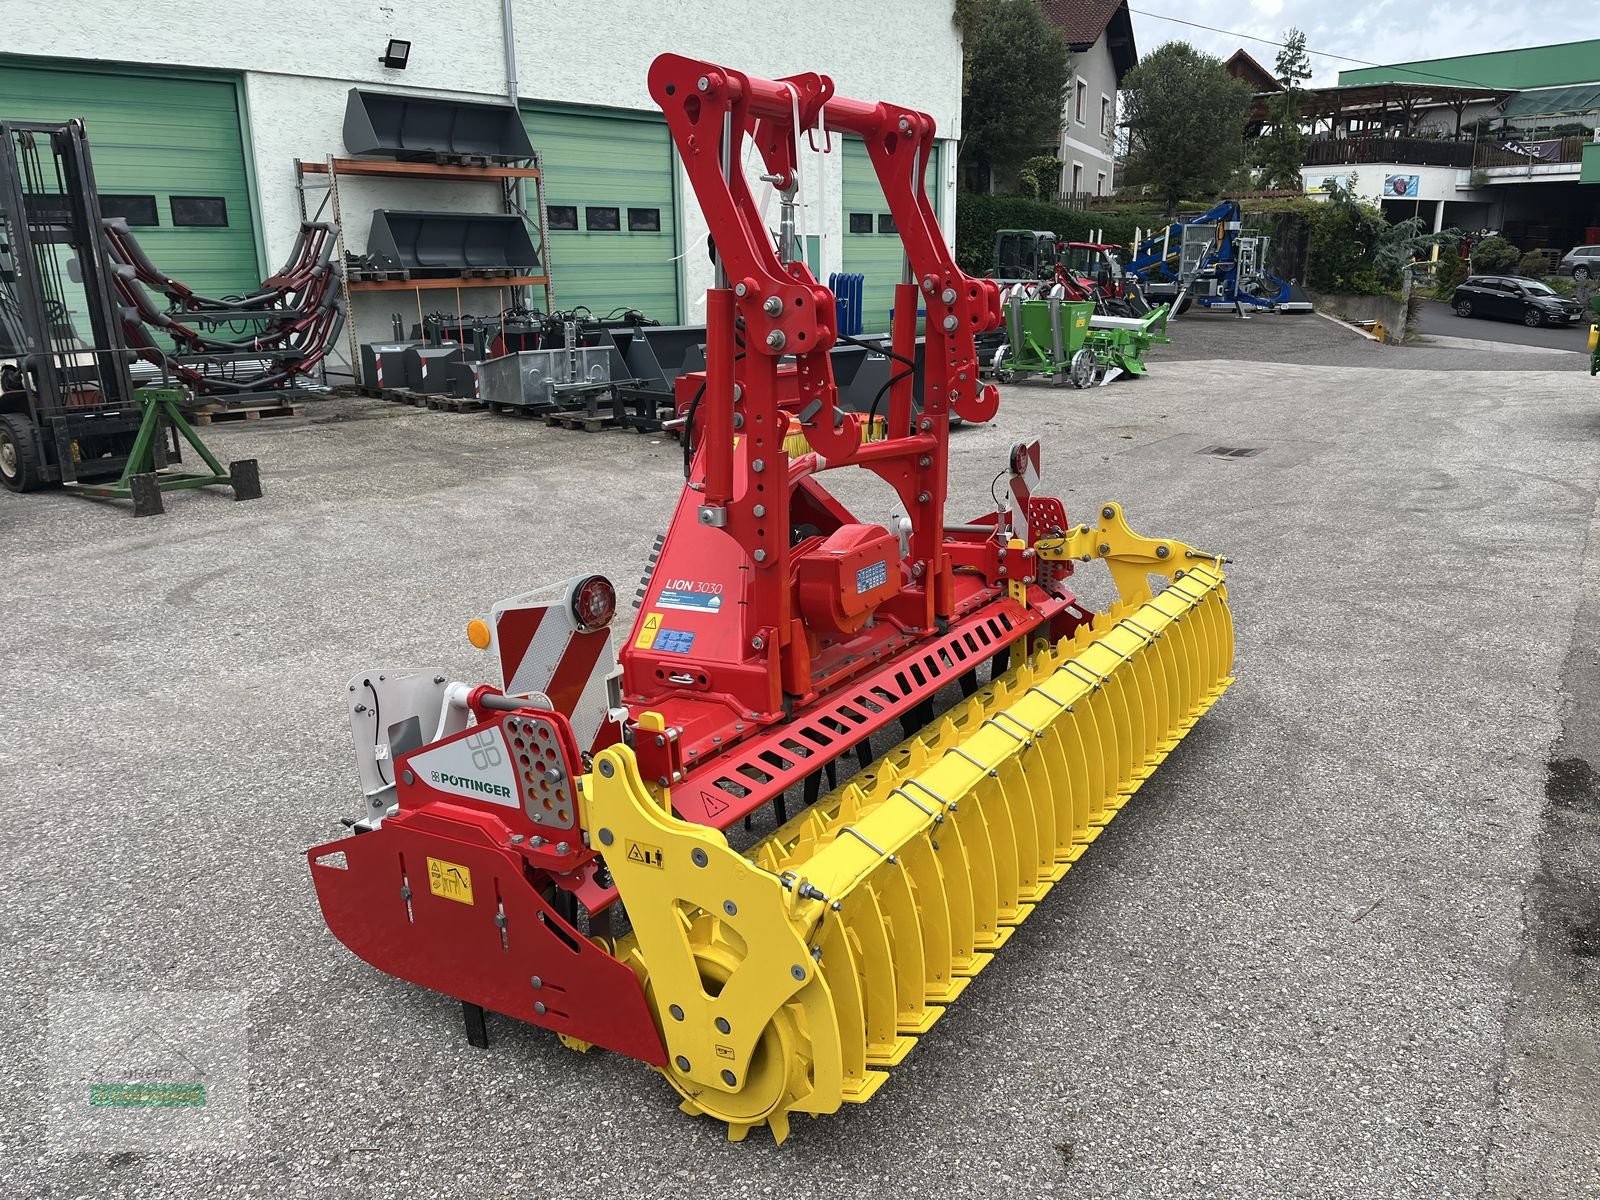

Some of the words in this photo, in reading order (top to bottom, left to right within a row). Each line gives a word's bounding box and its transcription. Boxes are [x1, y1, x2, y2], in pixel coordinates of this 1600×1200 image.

[6, 220, 22, 277] NISSAN
[665, 579, 694, 591] LION
[694, 582, 723, 595] 3030
[440, 773, 511, 798] PÖTTINGER
